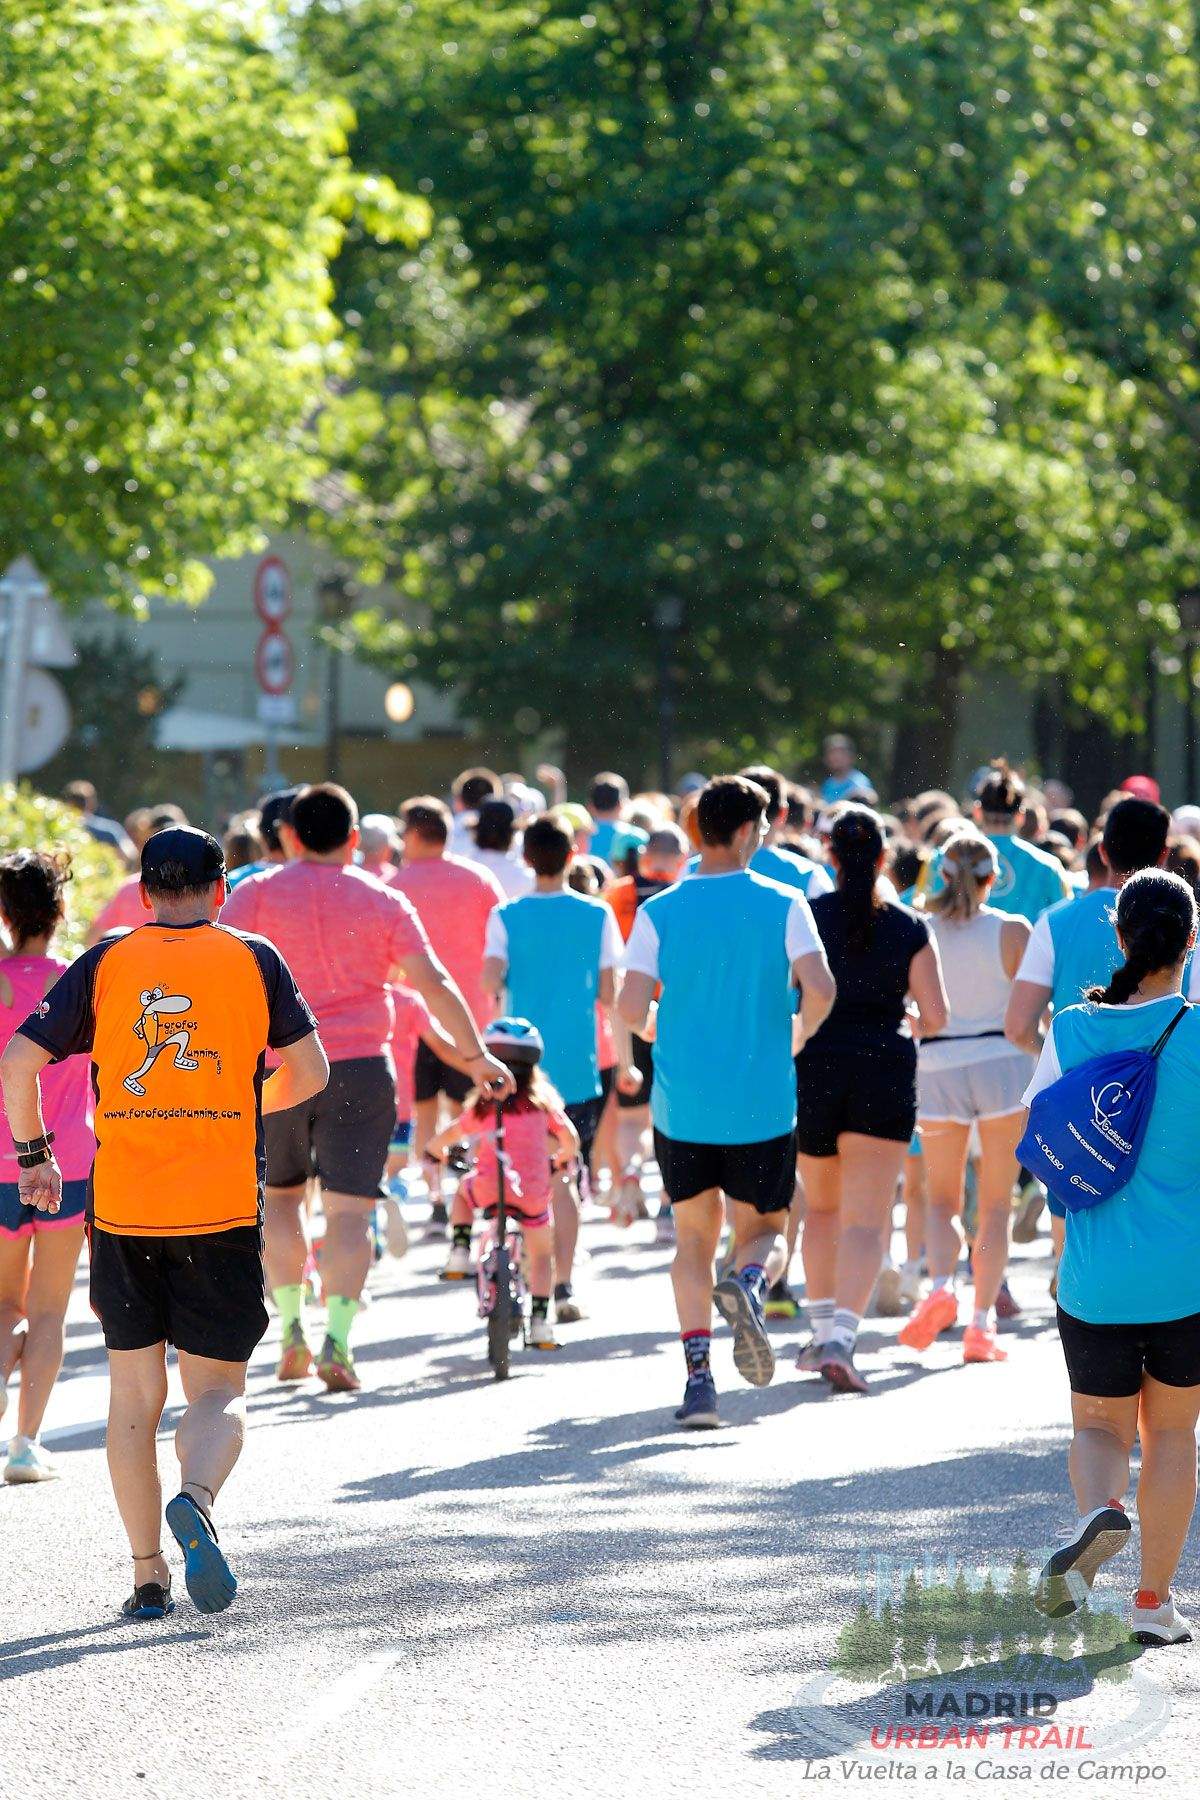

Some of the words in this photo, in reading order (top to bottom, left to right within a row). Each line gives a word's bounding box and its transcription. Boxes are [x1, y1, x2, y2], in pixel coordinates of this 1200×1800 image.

[104, 1107, 241, 1120] www.forofosdelrunning.com
[1067, 1121, 1082, 1141] TODOS
[1080, 1138, 1098, 1158] CONTRA
[1041, 1144, 1064, 1170] OCASO
